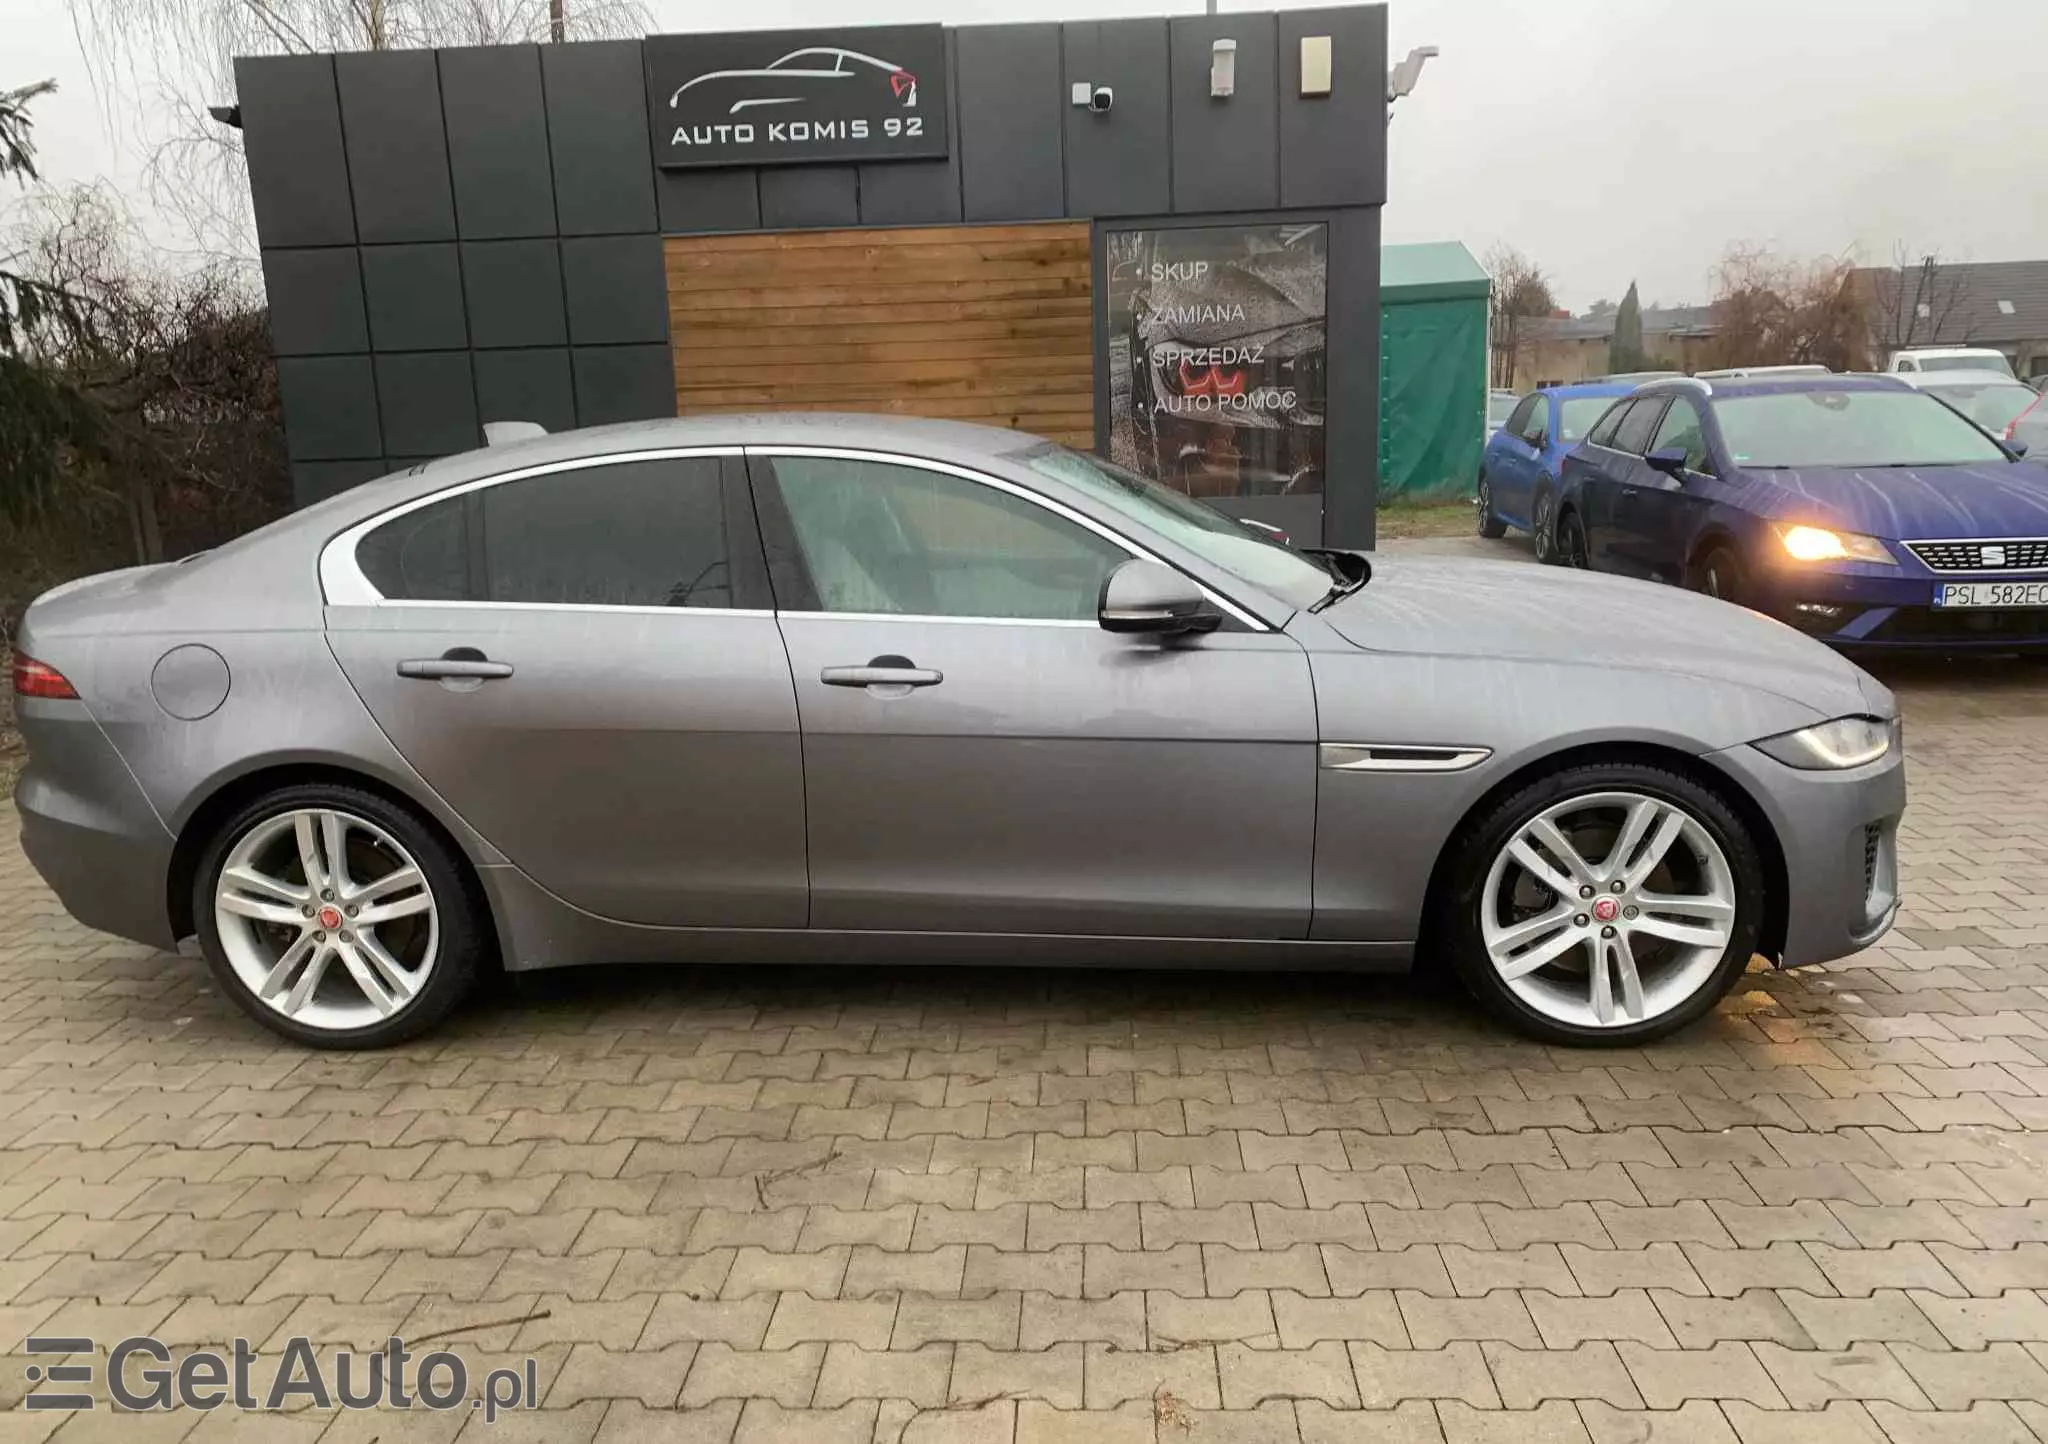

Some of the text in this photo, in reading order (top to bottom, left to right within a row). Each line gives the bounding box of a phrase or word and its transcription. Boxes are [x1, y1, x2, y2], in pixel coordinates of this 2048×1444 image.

[671, 117, 923, 146] AUTO KOMIS 92
[1151, 261, 1208, 281] SKUP
[1151, 303, 1246, 325] ZAMIANA
[1152, 343, 1265, 368] SPRZEDAŻ
[1154, 391, 1297, 413] AUTO POMOC
[1944, 585, 1981, 605] PSL
